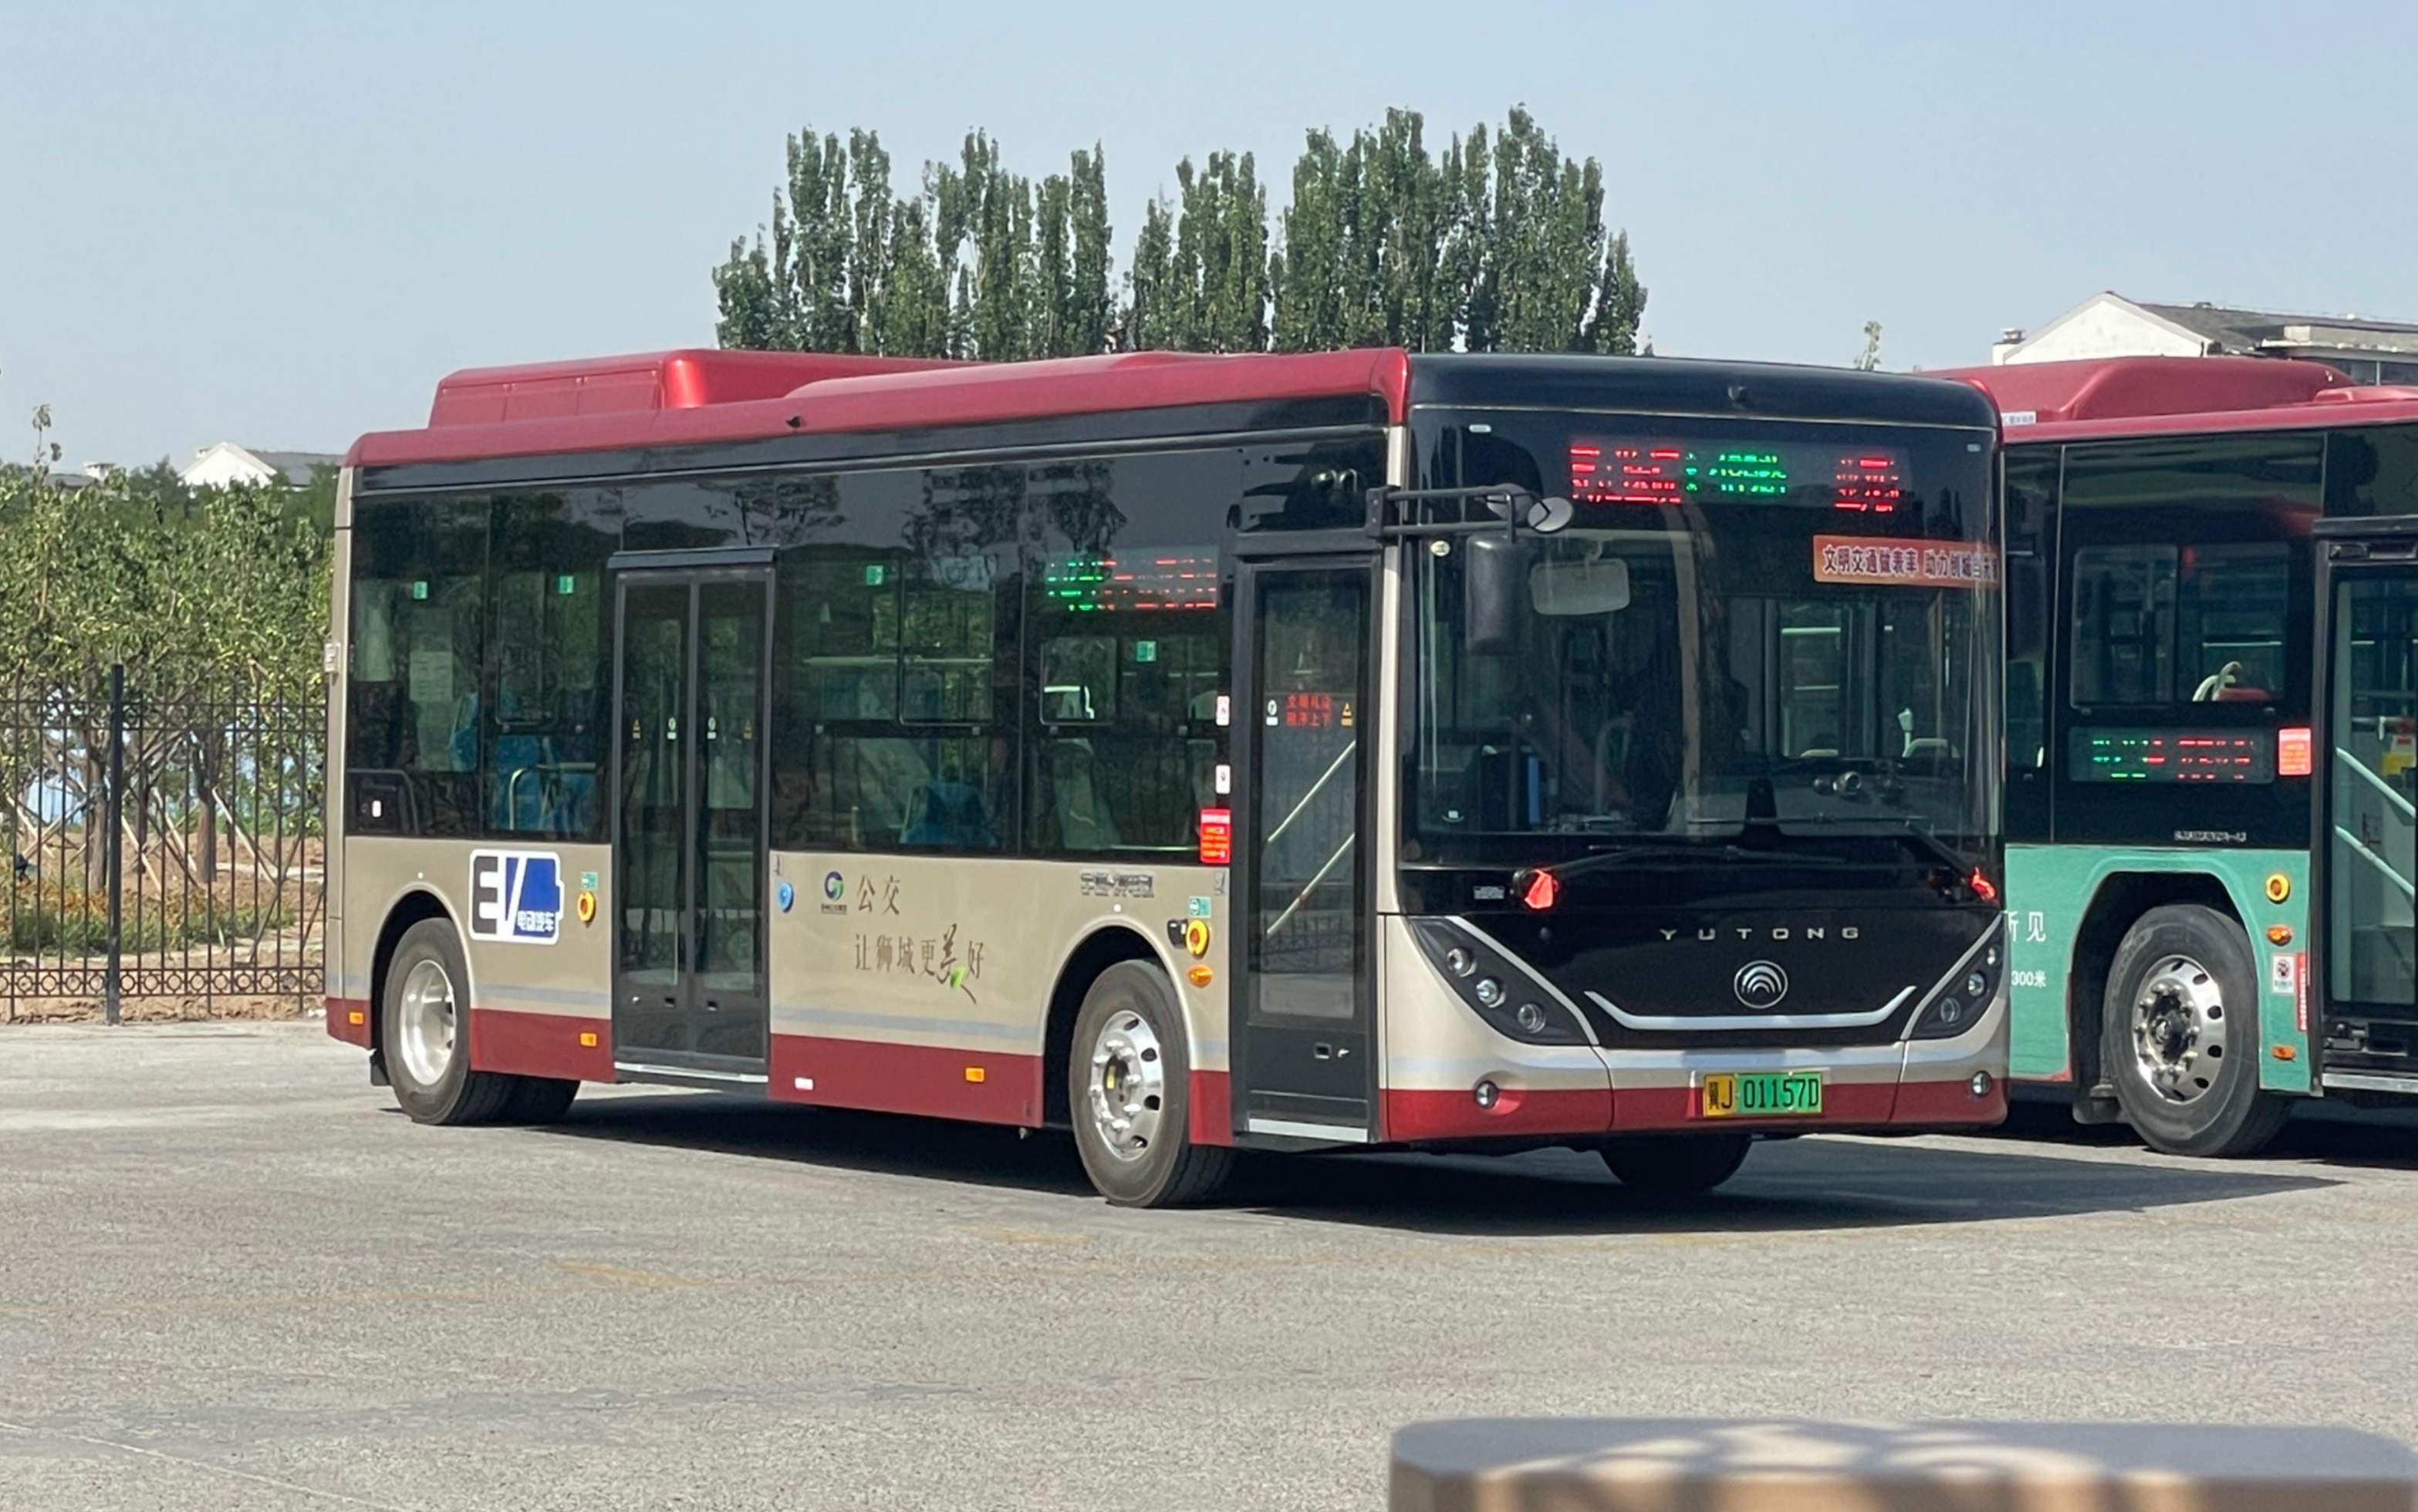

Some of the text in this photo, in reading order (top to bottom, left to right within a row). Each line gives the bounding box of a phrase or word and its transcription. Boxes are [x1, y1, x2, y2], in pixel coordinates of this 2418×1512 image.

[856, 874, 901, 916] 公交
[1660, 926, 1859, 941] YUTONG
[2011, 970, 2047, 988] 300米
